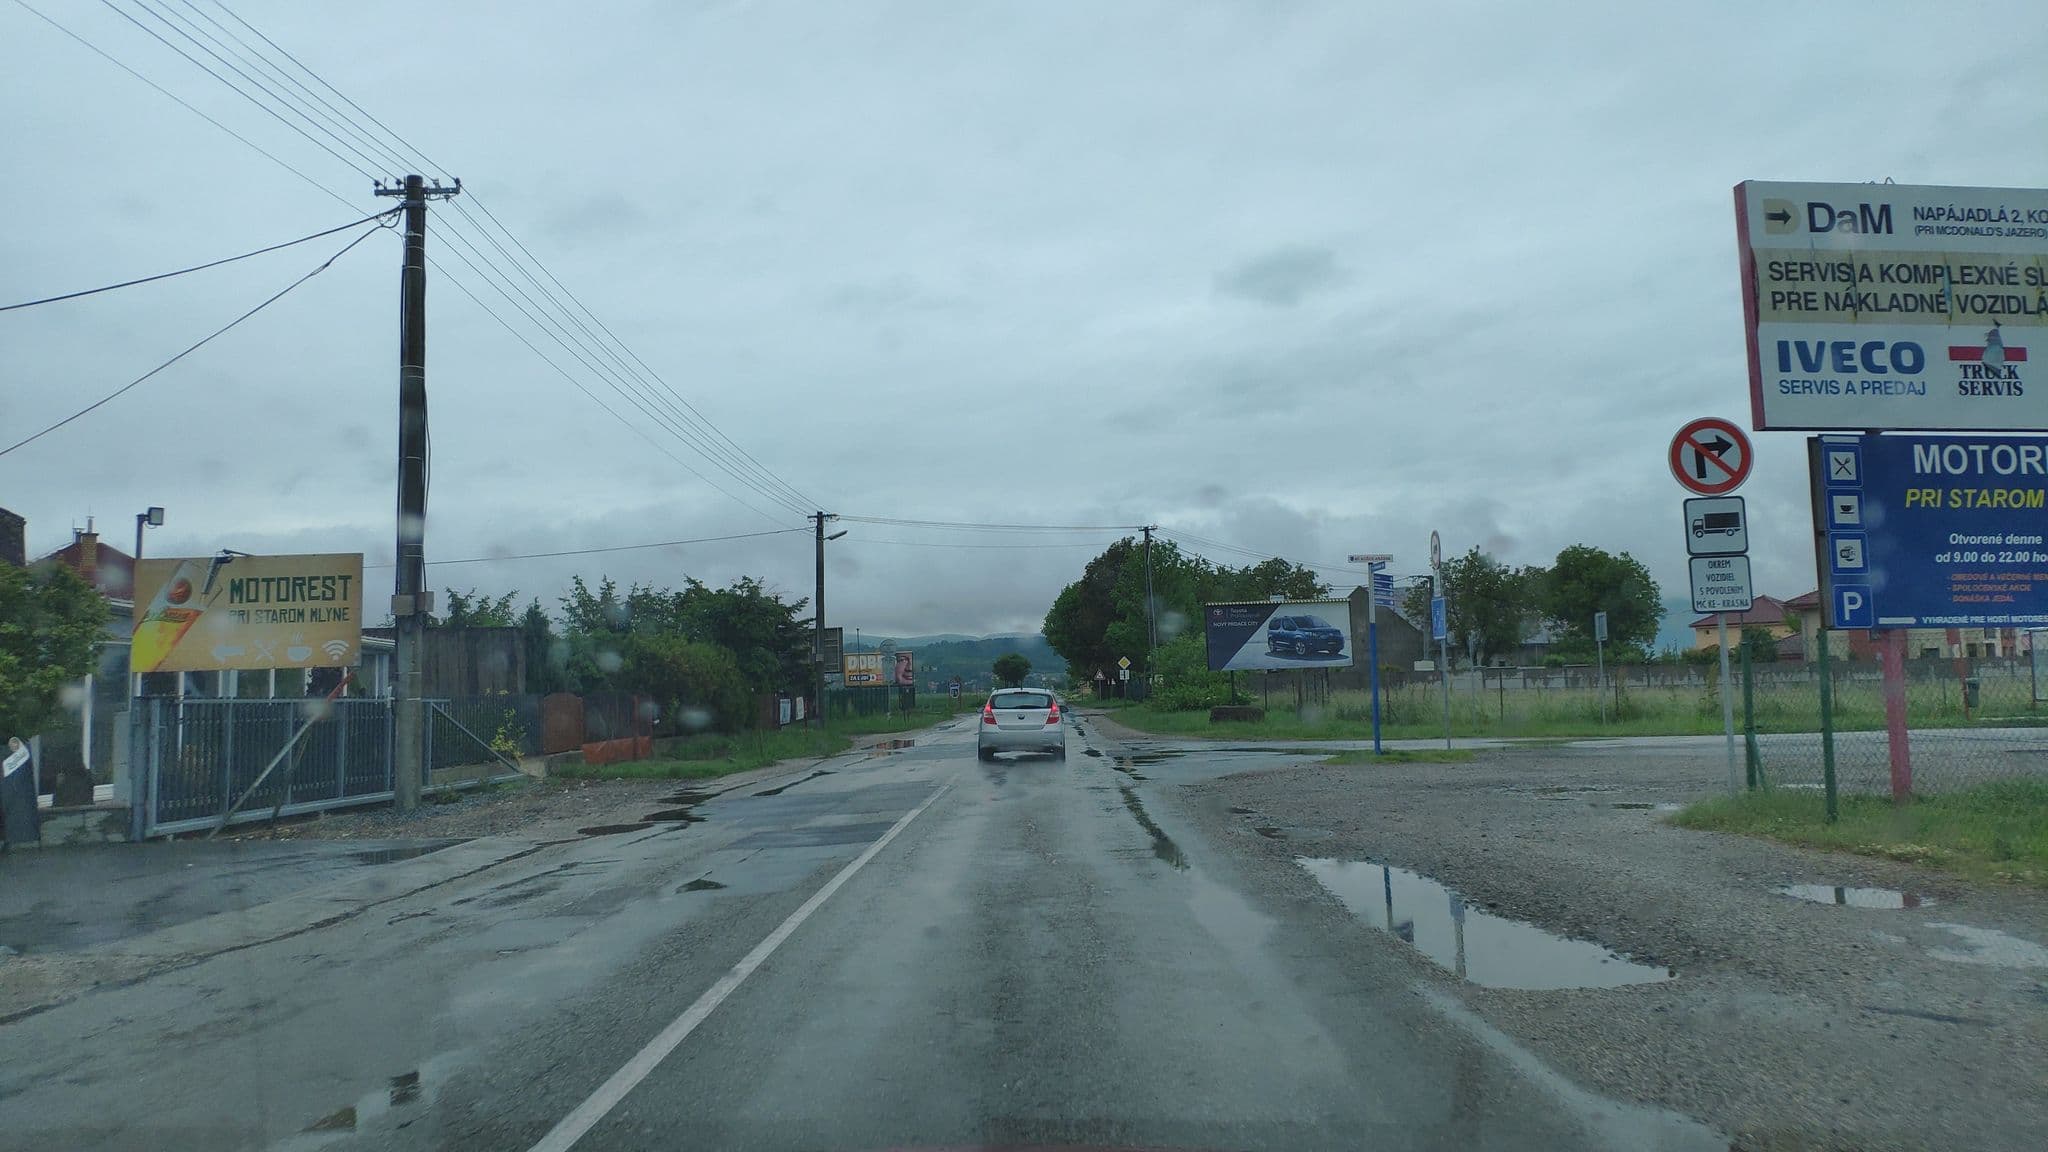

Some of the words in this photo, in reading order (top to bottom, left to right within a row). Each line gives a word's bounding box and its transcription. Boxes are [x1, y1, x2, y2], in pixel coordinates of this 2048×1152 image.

[1807, 202, 1893, 234] DaM
[1913, 203, 2009, 223] NAPÁJADLÁ
[1768, 261, 1850, 283] SERVIS
[1858, 263, 1874, 283] A
[1880, 261, 2020, 286] KOMPLEXNÉ
[1771, 291, 1818, 311] PRE
[1824, 288, 1949, 314] NÁKLADNÉ
[1955, 289, 2048, 316] VOZIDLÁ
[1776, 340, 1925, 375] IVECO
[1958, 364, 2020, 381] TRUCK
[1779, 380, 1840, 396] SERVIS
[1845, 380, 1857, 395] A
[1861, 380, 1926, 396] PREDAJ
[1958, 380, 2024, 398] SERVIS
[1913, 444, 2048, 475] MOTOR
[1905, 488, 1942, 508] PRI
[1948, 488, 2045, 508] STAROM
[1949, 533, 2003, 545] Otvorené
[2005, 533, 2043, 545] denne
[1708, 560, 1731, 569] OKREM
[1935, 552, 1951, 563] od
[1953, 552, 1978, 563] 9.00
[1980, 552, 1996, 563] do
[1998, 552, 2030, 564] 22.00
[2032, 552, 2048, 564] ho
[1706, 573, 1735, 582] VOZIDIEL
[230, 575, 352, 604] MOTOREST
[1699, 587, 1704, 596] S
[1843, 592, 1862, 621] P
[229, 609, 250, 624] PRI
[255, 608, 304, 624] STAROM
[310, 607, 350, 623] MLYNE
[1922, 615, 1969, 624] VYHRADENÉ
[1970, 615, 1986, 624] PRE
